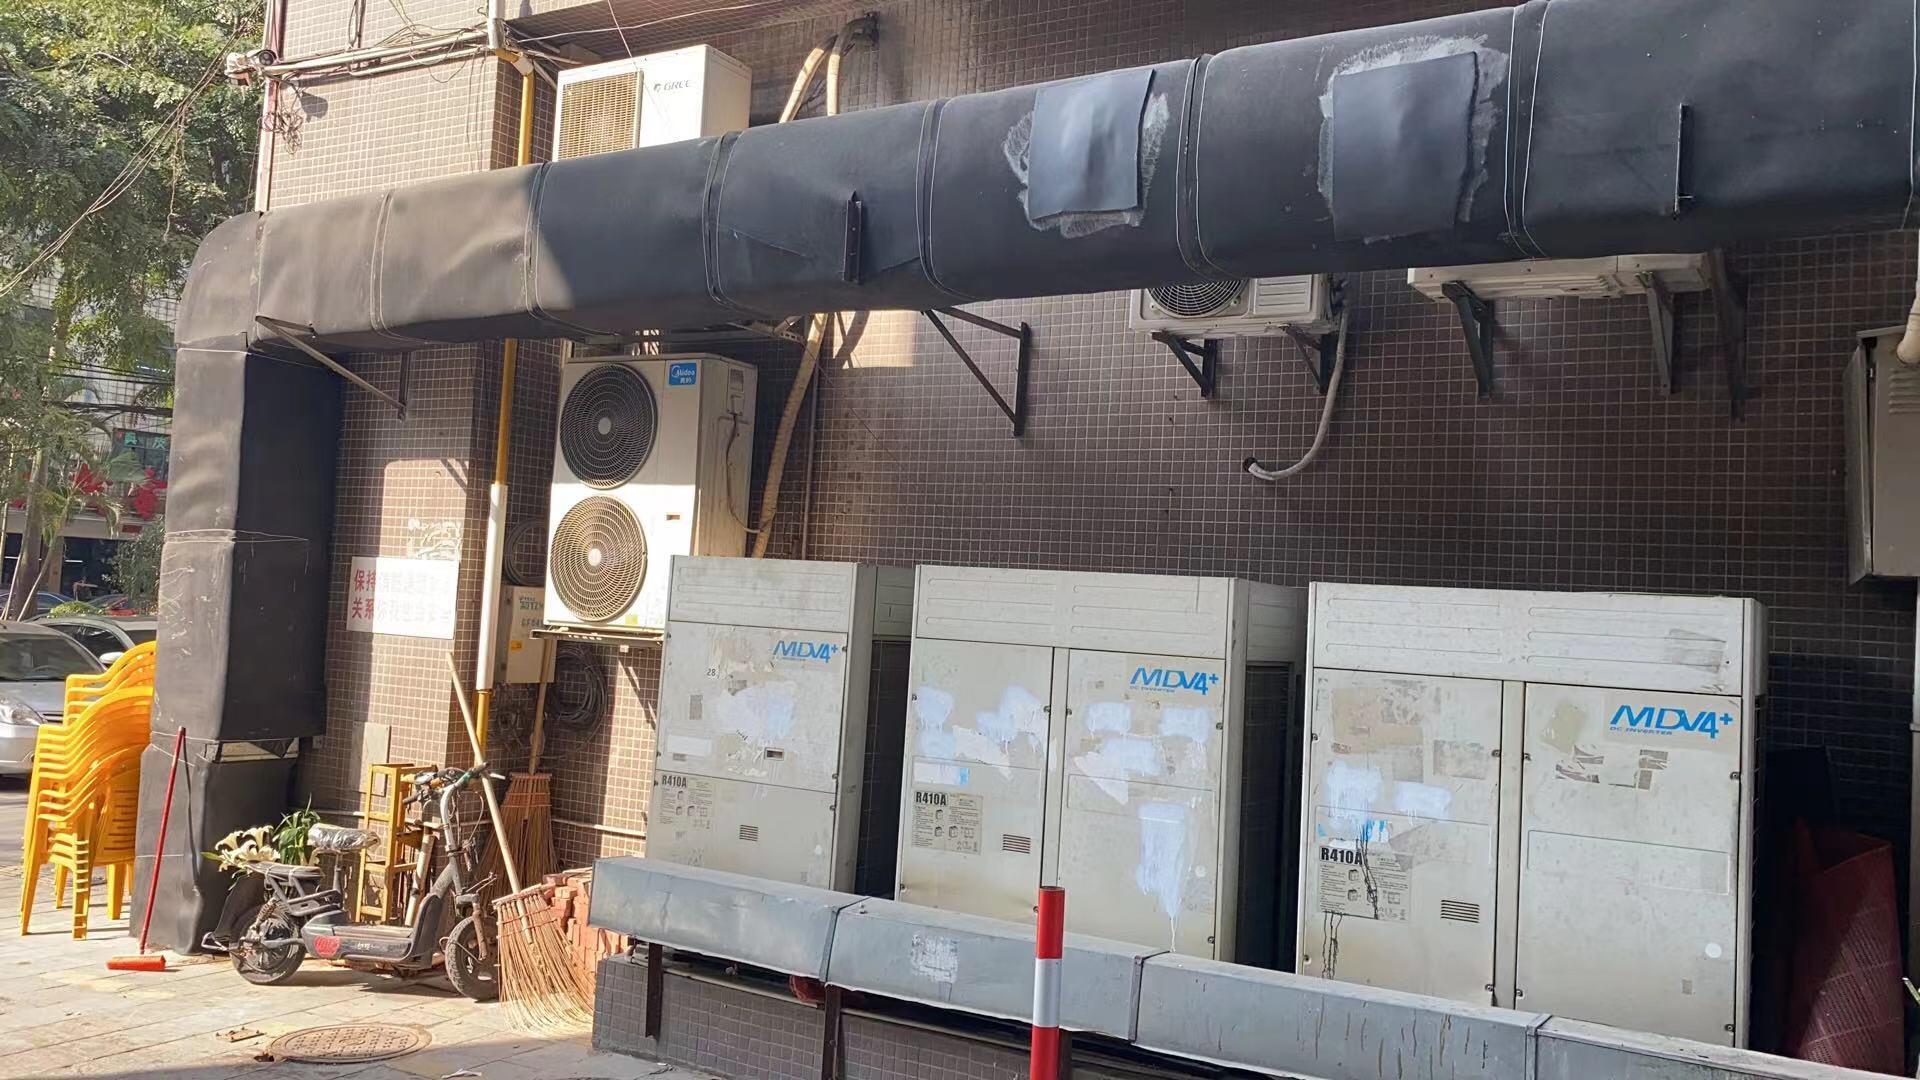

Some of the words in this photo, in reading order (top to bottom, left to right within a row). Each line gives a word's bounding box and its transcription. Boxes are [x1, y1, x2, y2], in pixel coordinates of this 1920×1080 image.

[671, 365, 696, 377] Midea
[1626, 727, 1673, 735] INVERTER
[662, 774, 687, 788] R410A
[915, 791, 947, 806] R410A
[1321, 847, 1363, 865] R410A
